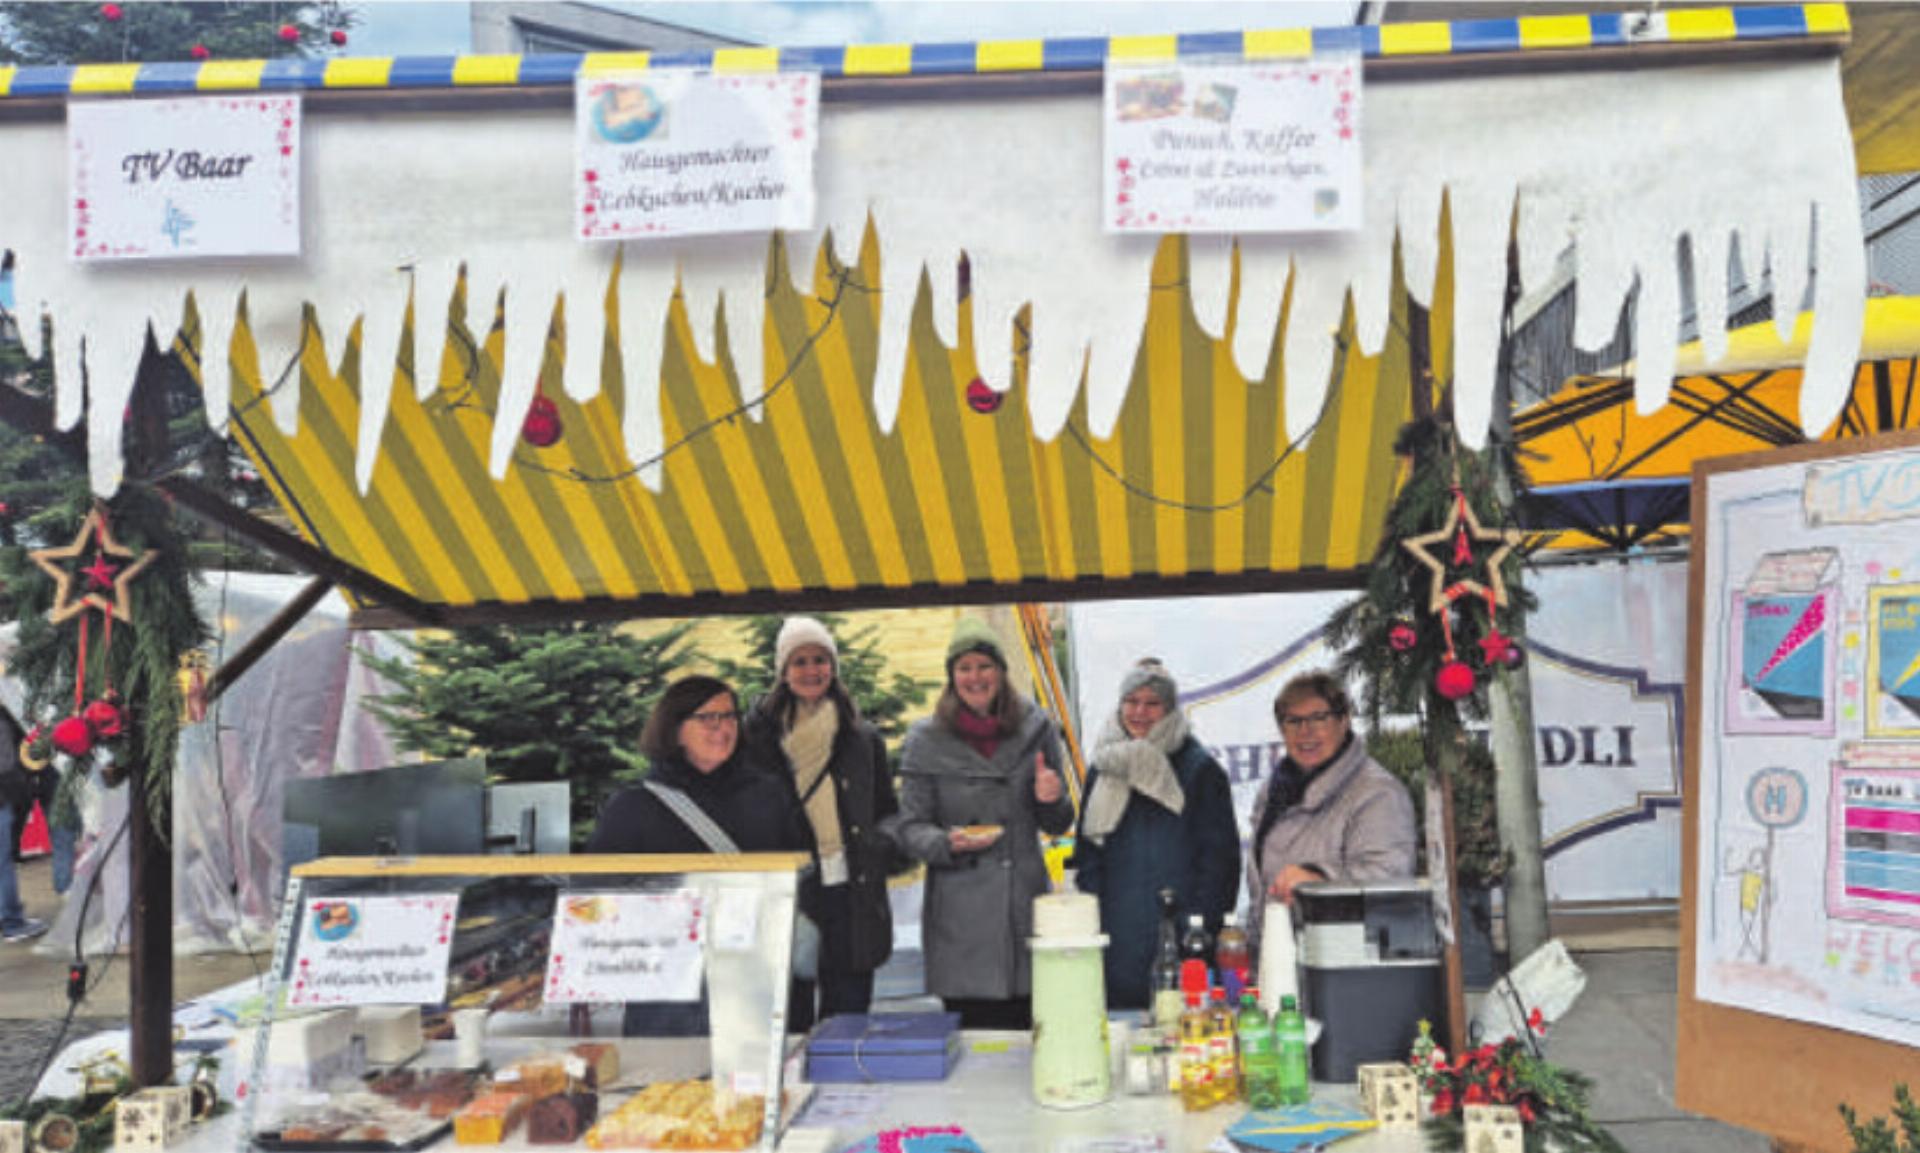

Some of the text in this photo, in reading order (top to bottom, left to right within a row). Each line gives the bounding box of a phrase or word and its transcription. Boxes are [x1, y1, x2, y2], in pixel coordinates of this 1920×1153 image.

[121, 147, 254, 184] TV Baar
[1538, 725, 1638, 769] DLI
